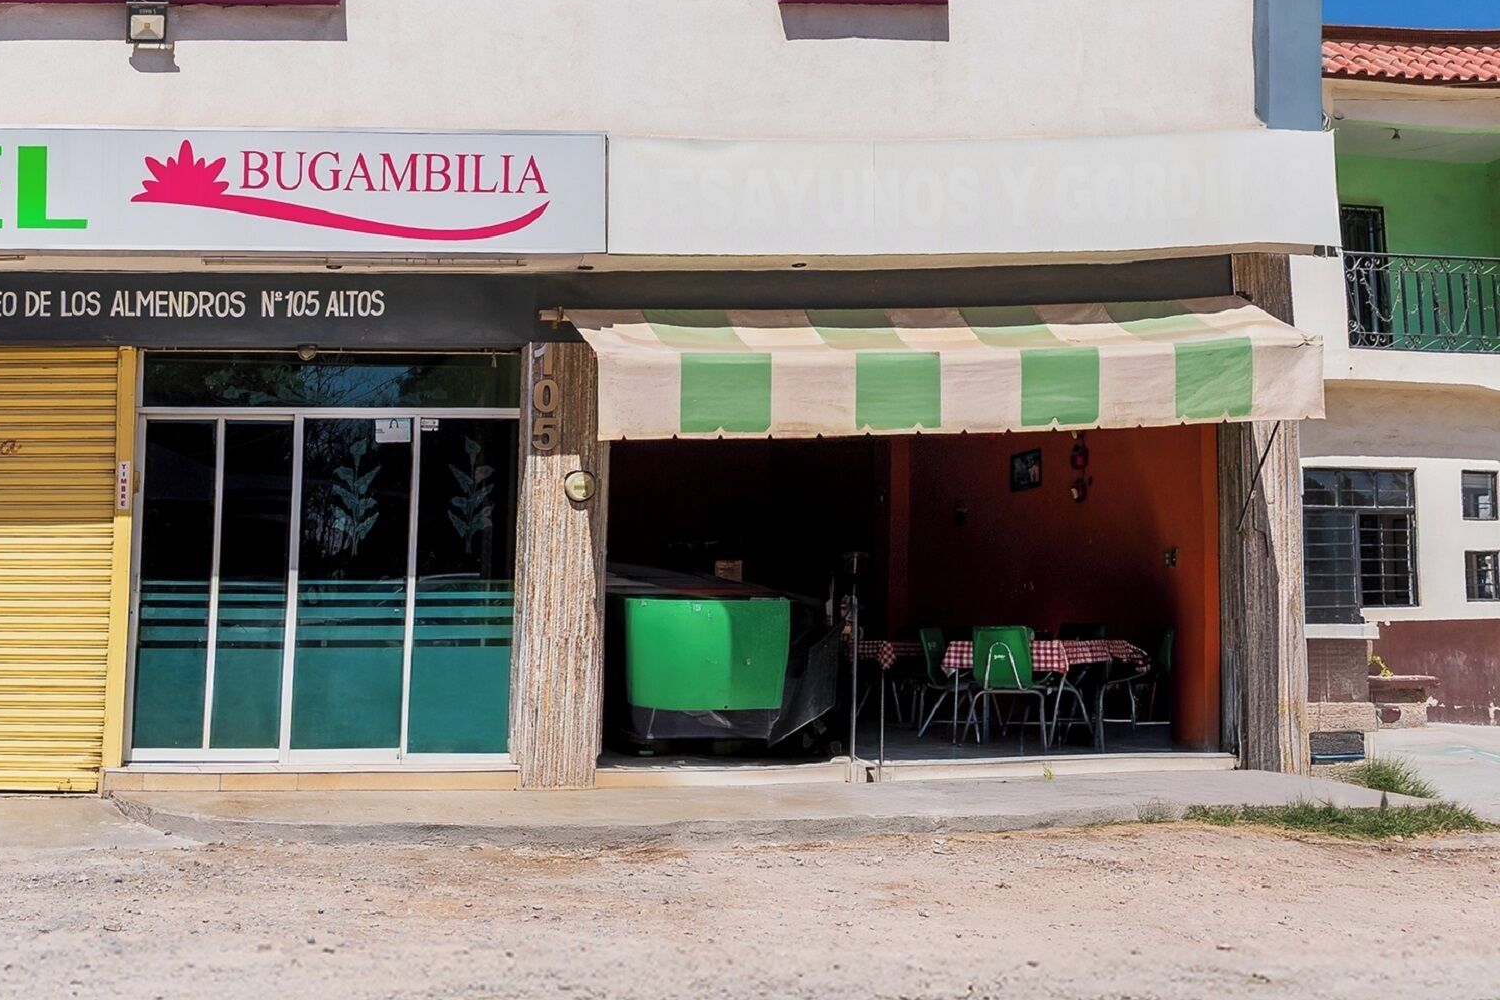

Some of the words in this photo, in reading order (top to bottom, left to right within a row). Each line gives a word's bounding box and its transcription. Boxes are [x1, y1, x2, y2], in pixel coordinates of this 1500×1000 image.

[238, 149, 550, 195] BUGAMBILIA
[24, 290, 52, 318] DE
[60, 290, 102, 318] LOS
[110, 290, 247, 318] ALMENDROS
[325, 290, 386, 318] ALTOS
